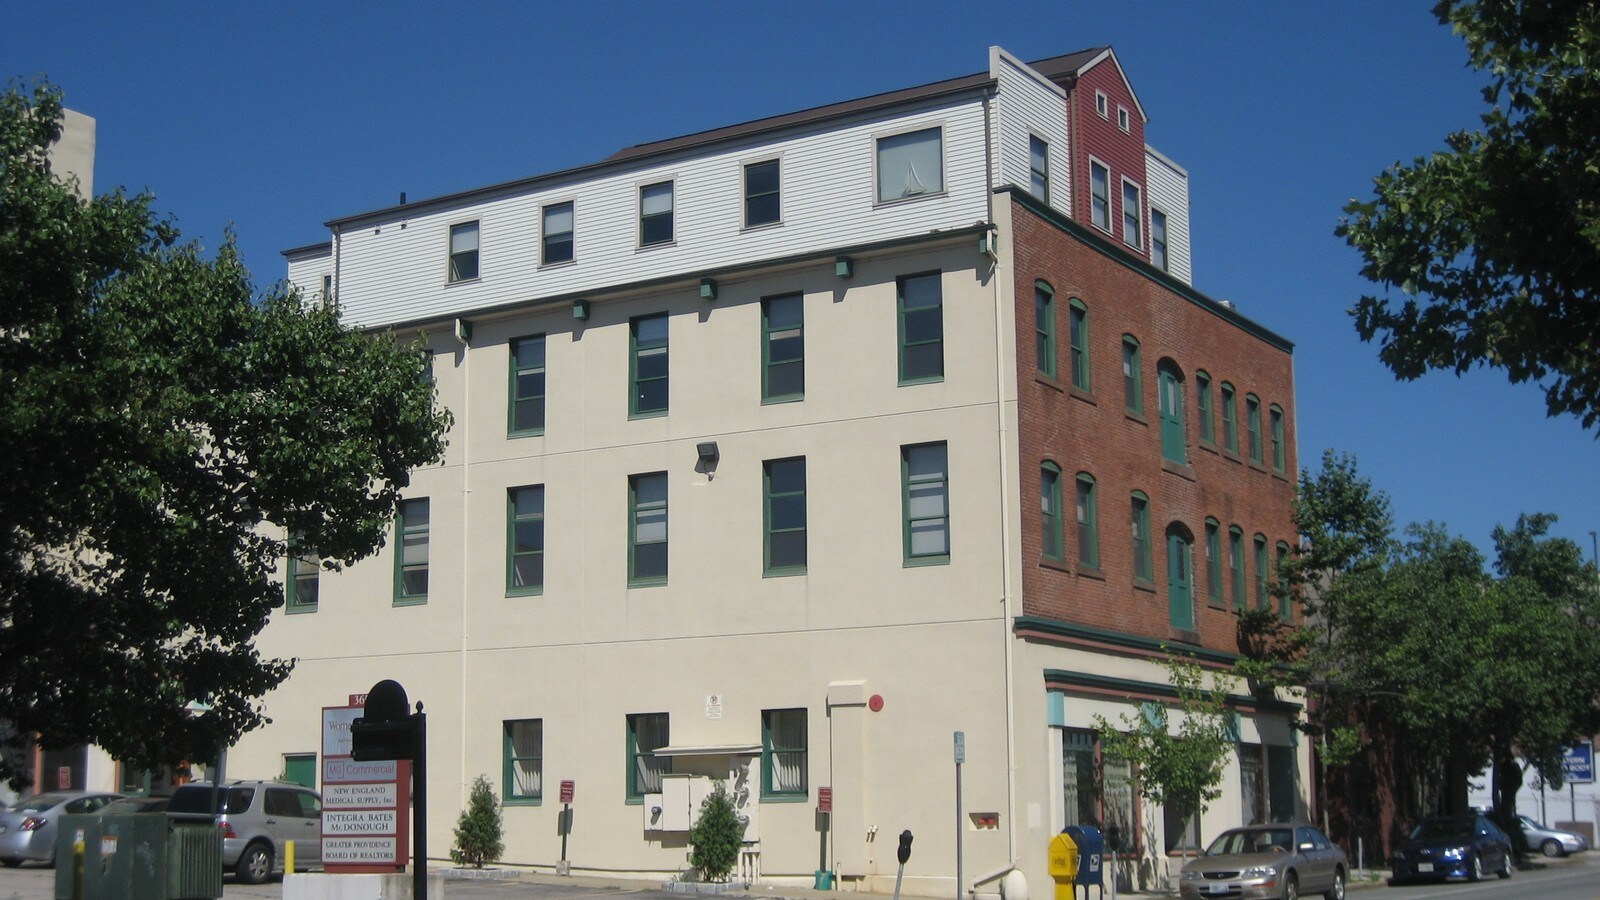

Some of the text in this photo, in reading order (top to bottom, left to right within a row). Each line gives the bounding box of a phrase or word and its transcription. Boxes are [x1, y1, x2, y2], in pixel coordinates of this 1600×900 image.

[329, 721, 353, 730] Wome
[329, 764, 393, 775] MG Commercial
[334, 787, 386, 795] NEW ENGLAND
[356, 797, 382, 805] SUPPLY,
[327, 813, 393, 822] INTEGRA BATES
[331, 823, 389, 831] McDONOUGH
